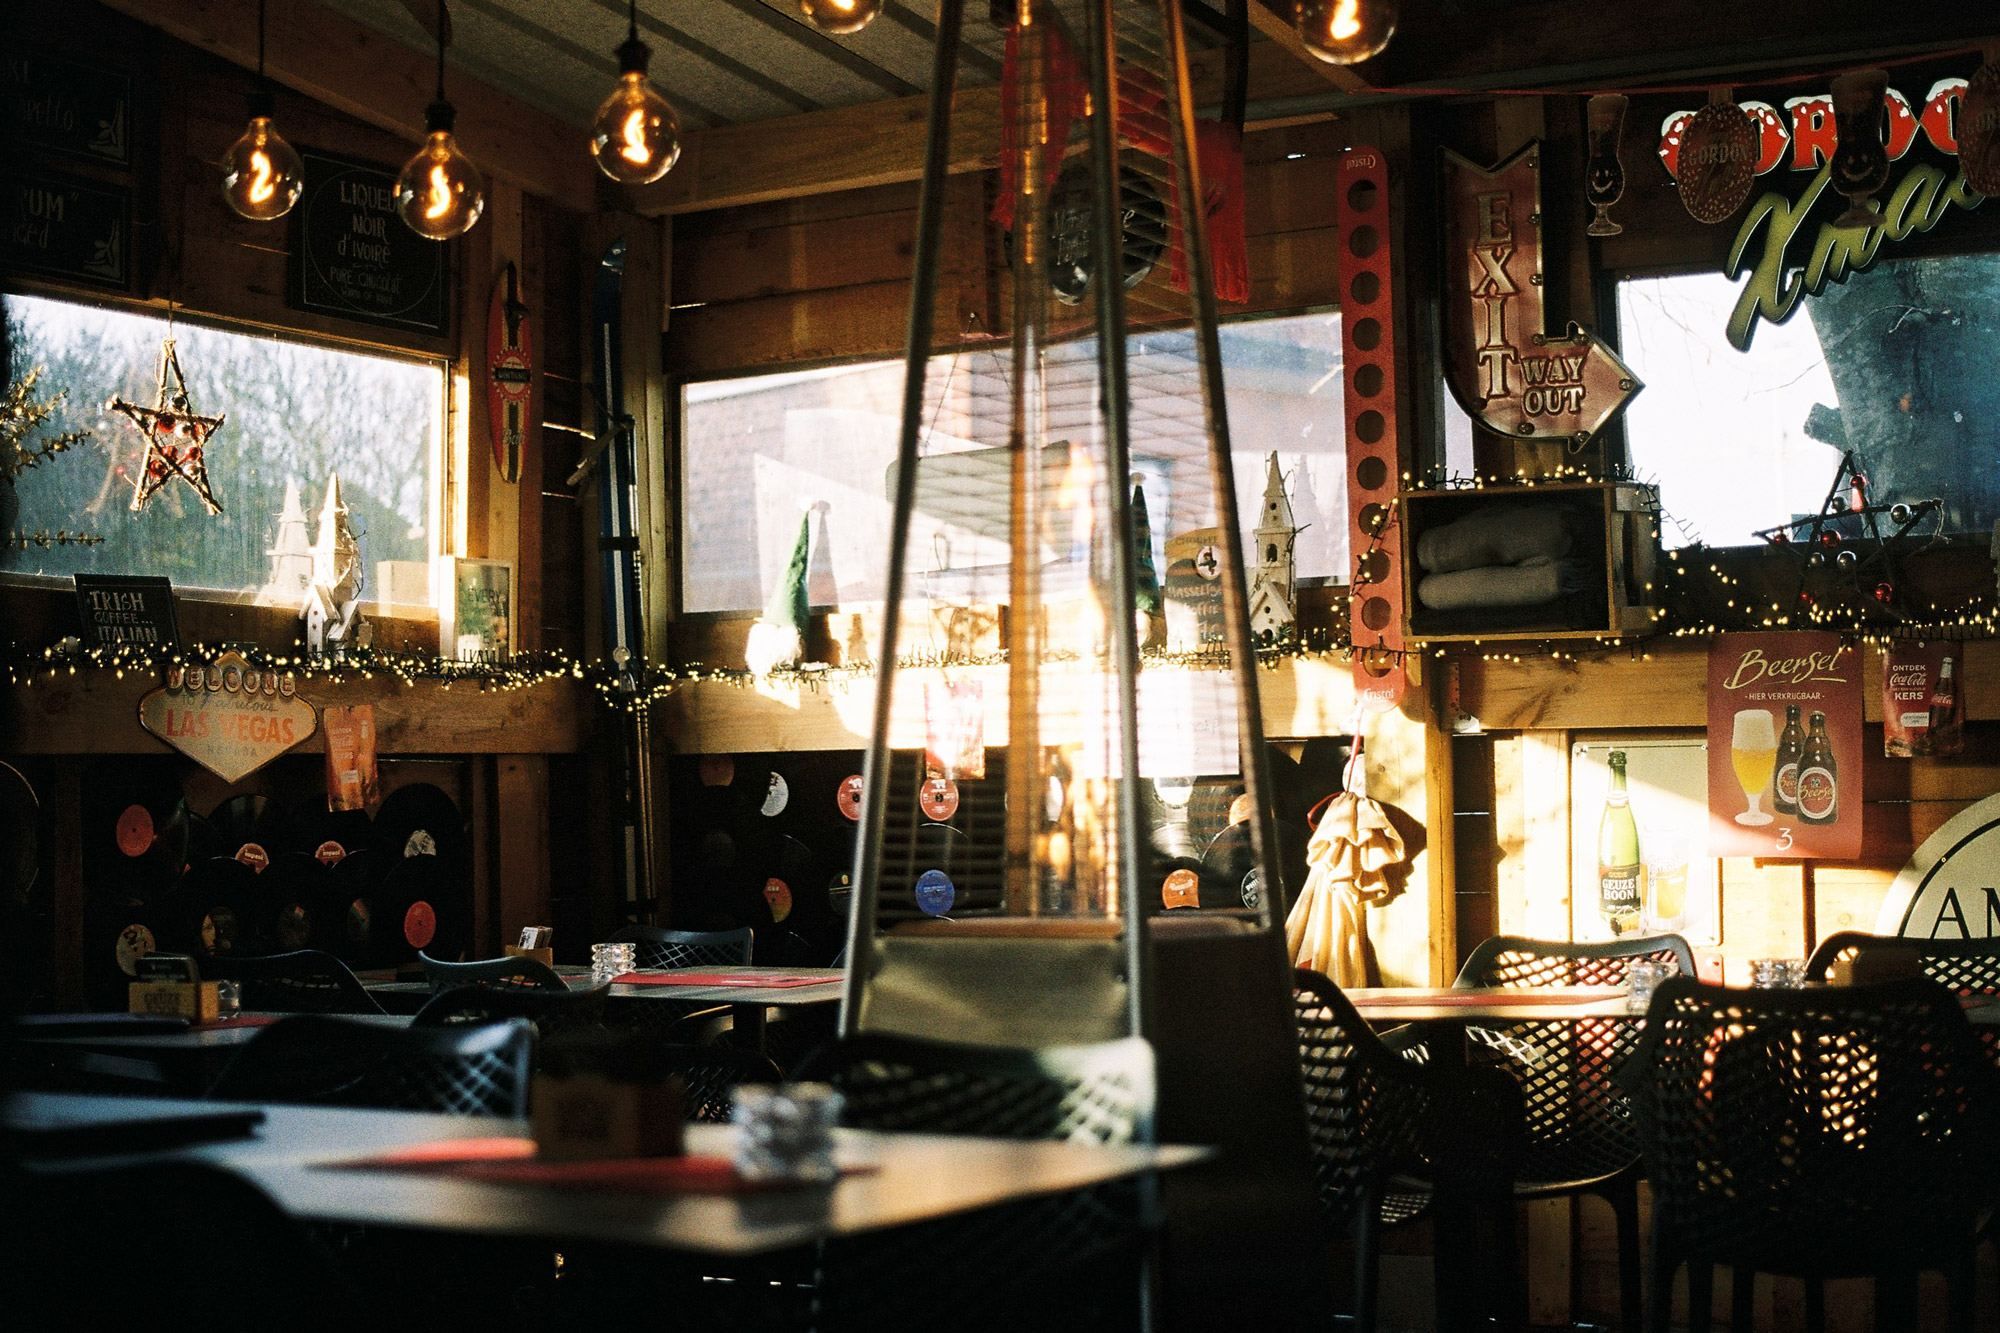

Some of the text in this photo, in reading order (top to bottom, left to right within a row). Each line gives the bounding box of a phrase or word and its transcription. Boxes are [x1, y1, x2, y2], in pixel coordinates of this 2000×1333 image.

[1689, 143, 1748, 165] GORDON
[339, 180, 402, 216] LIQUEU
[353, 214, 390, 246] NOIR
[1471, 193, 1519, 398] EXIT
[1520, 355, 1587, 385] WAY
[1524, 386, 1586, 415] OUT
[90, 590, 144, 612] IRISH
[167, 667, 294, 694] WELCOME
[1723, 644, 1847, 690] Beersel
[1749, 692, 1766, 700] HIER
[1895, 692, 1924, 700] KERS
[167, 709, 294, 745] LAS VEGAS
[1776, 828, 1793, 850] 3
[1602, 877, 1635, 890] GEUZE
[1603, 888, 1634, 901] BOON
